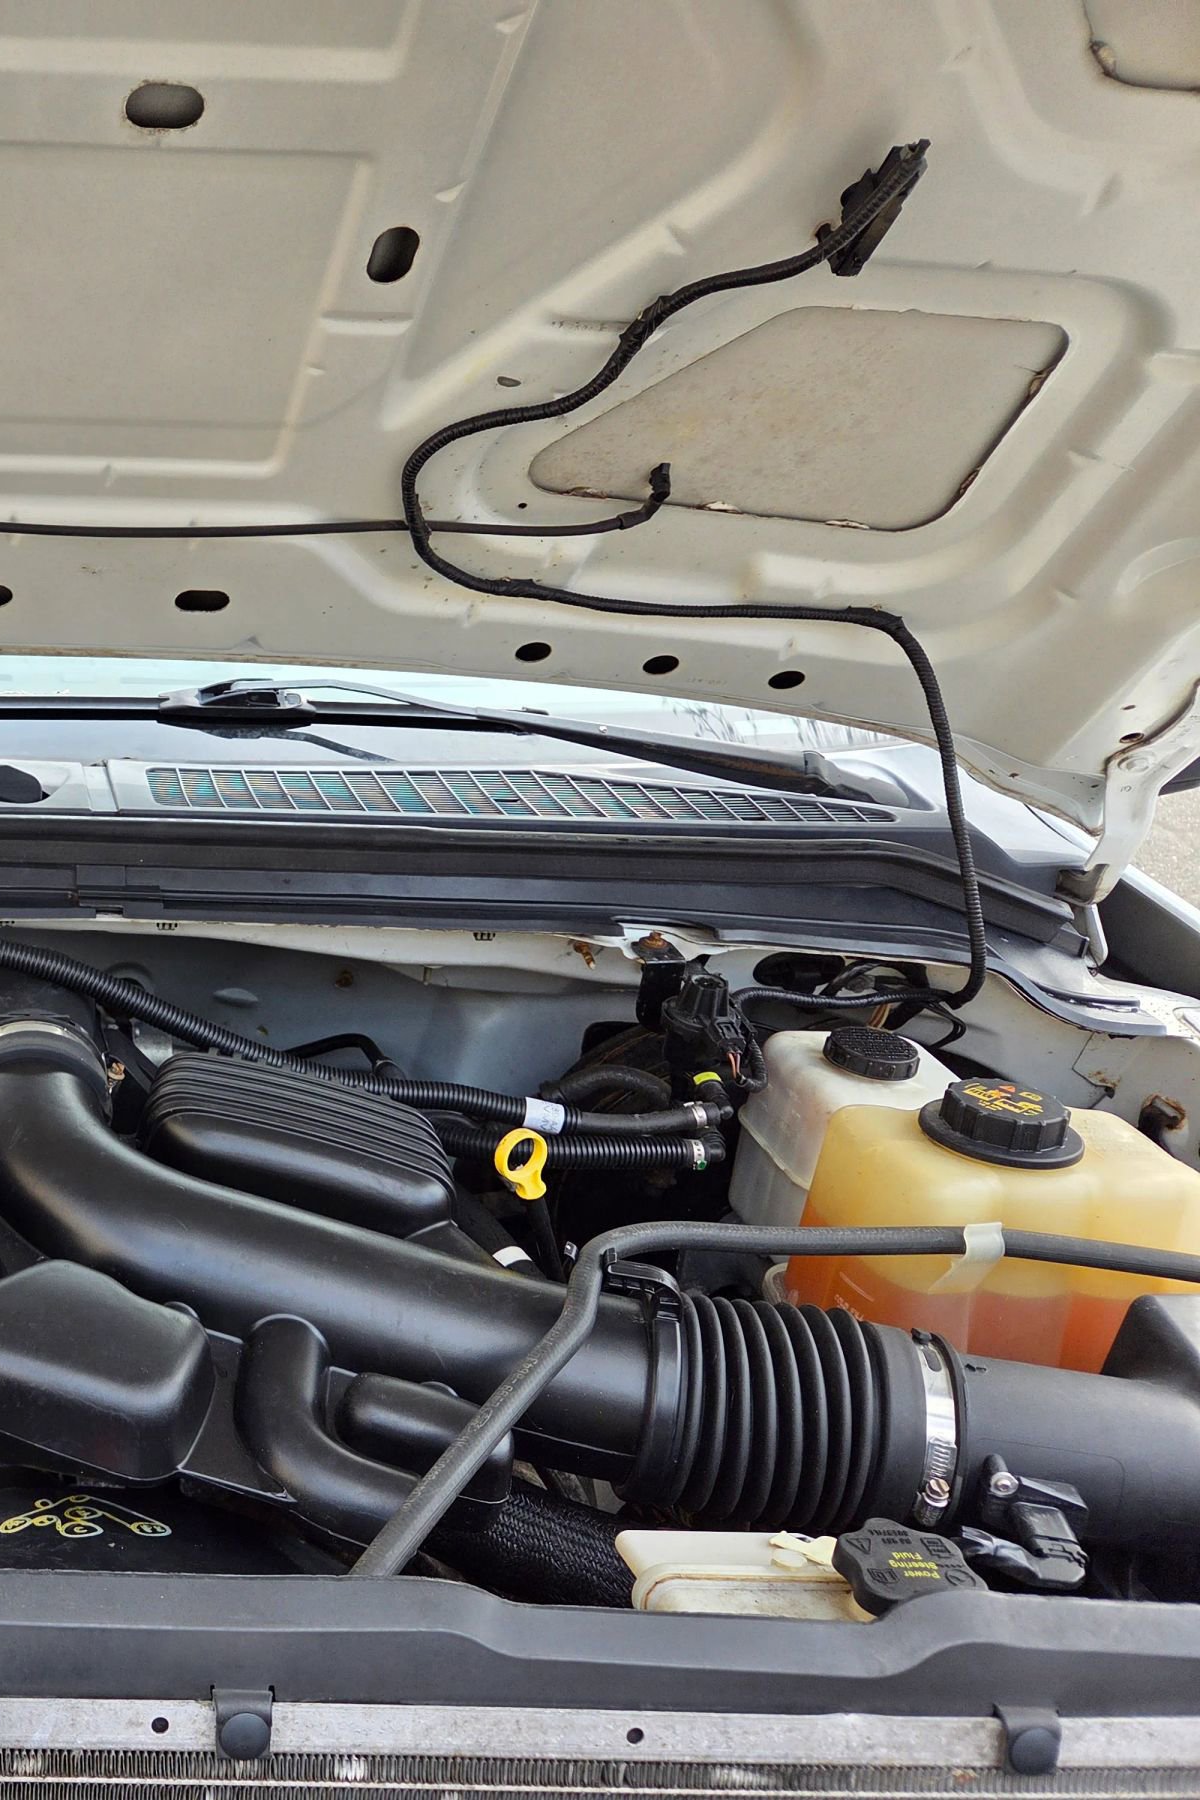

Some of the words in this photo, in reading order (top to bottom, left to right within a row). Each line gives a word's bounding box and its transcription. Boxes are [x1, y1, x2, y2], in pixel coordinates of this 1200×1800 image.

[892, 1551, 923, 1560] Fluid
[888, 1559, 940, 1570] Steering
[904, 1570, 941, 1579] Power
